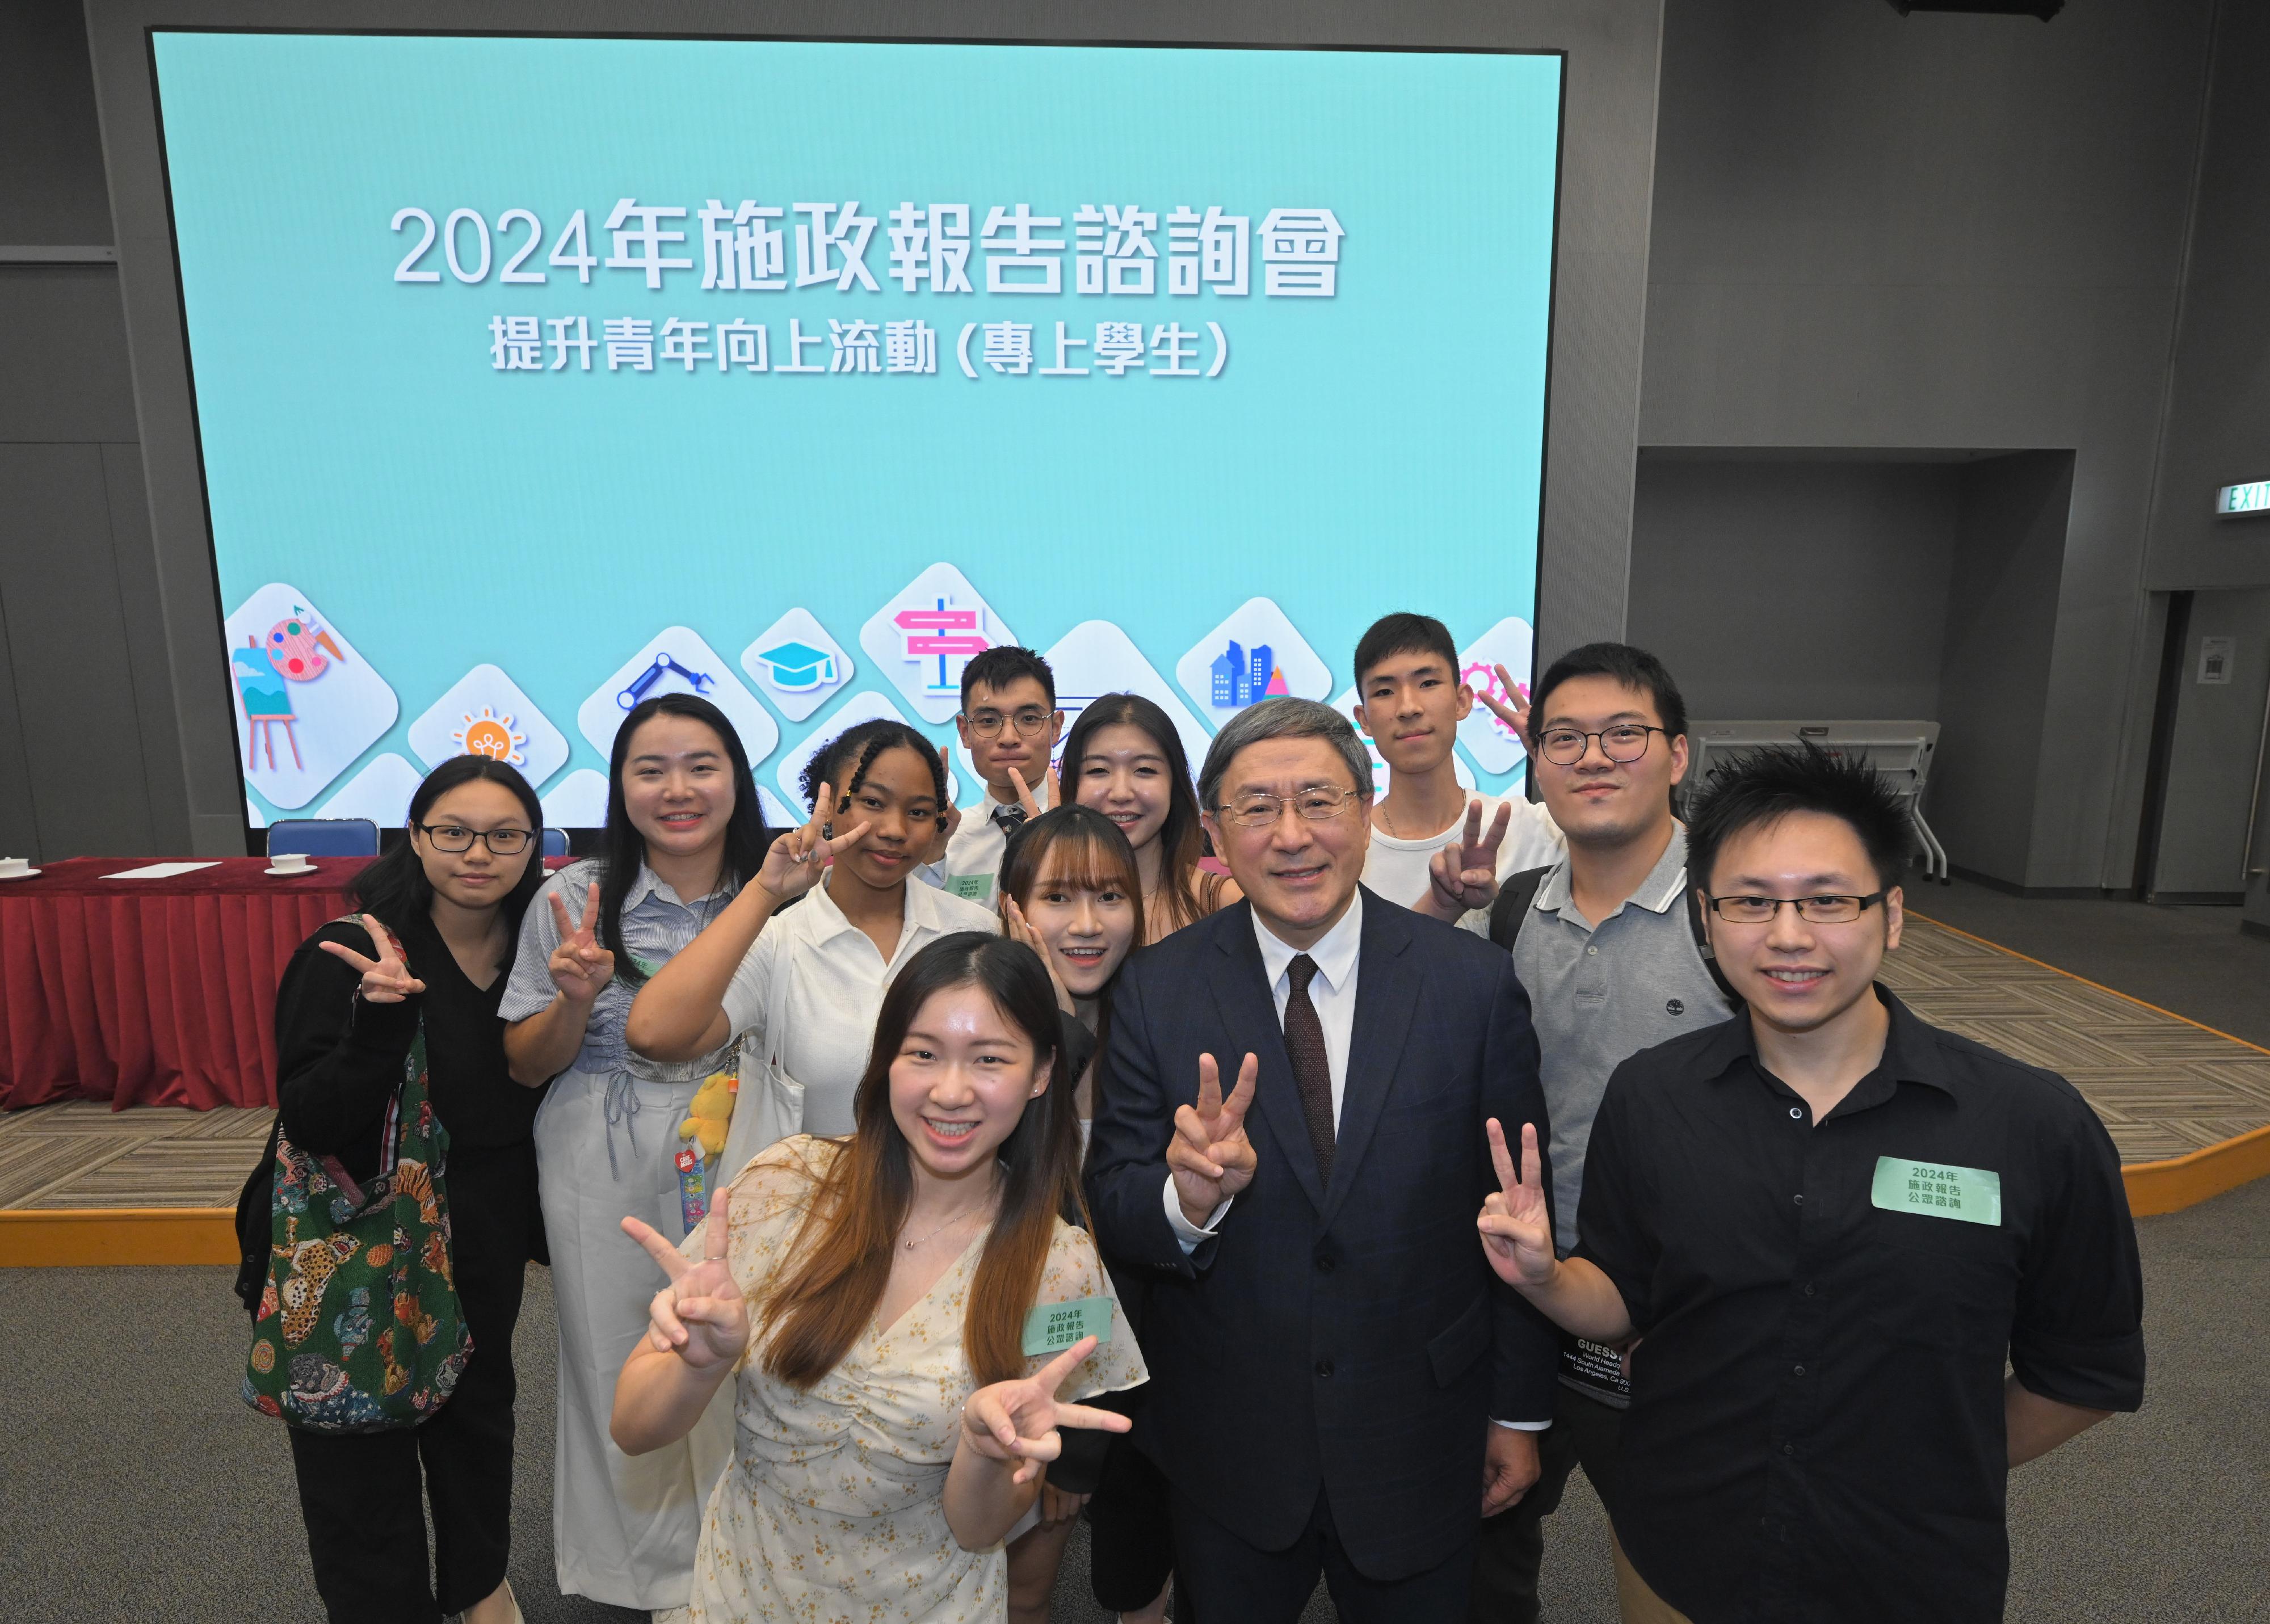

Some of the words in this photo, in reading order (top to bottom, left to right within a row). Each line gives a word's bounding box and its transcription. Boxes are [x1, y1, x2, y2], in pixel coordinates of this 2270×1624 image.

[390, 197, 1345, 297] 2024年施政報告諮詢會
[2228, 483, 2270, 510] EXIT
[1912, 1167, 1958, 1182] 2024年
[1909, 1180, 1961, 1196] 施政報告
[1909, 1192, 1961, 1209] 公眾諮詢
[1050, 1310, 1082, 1322] 2024年
[1047, 1320, 1083, 1335] 施政報告
[1047, 1331, 1083, 1345] 公眾諮詢
[1563, 1352, 1577, 1361] 1444
[1577, 1357, 1594, 1368] South
[1594, 1364, 1620, 1376] Alameda
[1583, 1352, 1600, 1362] World
